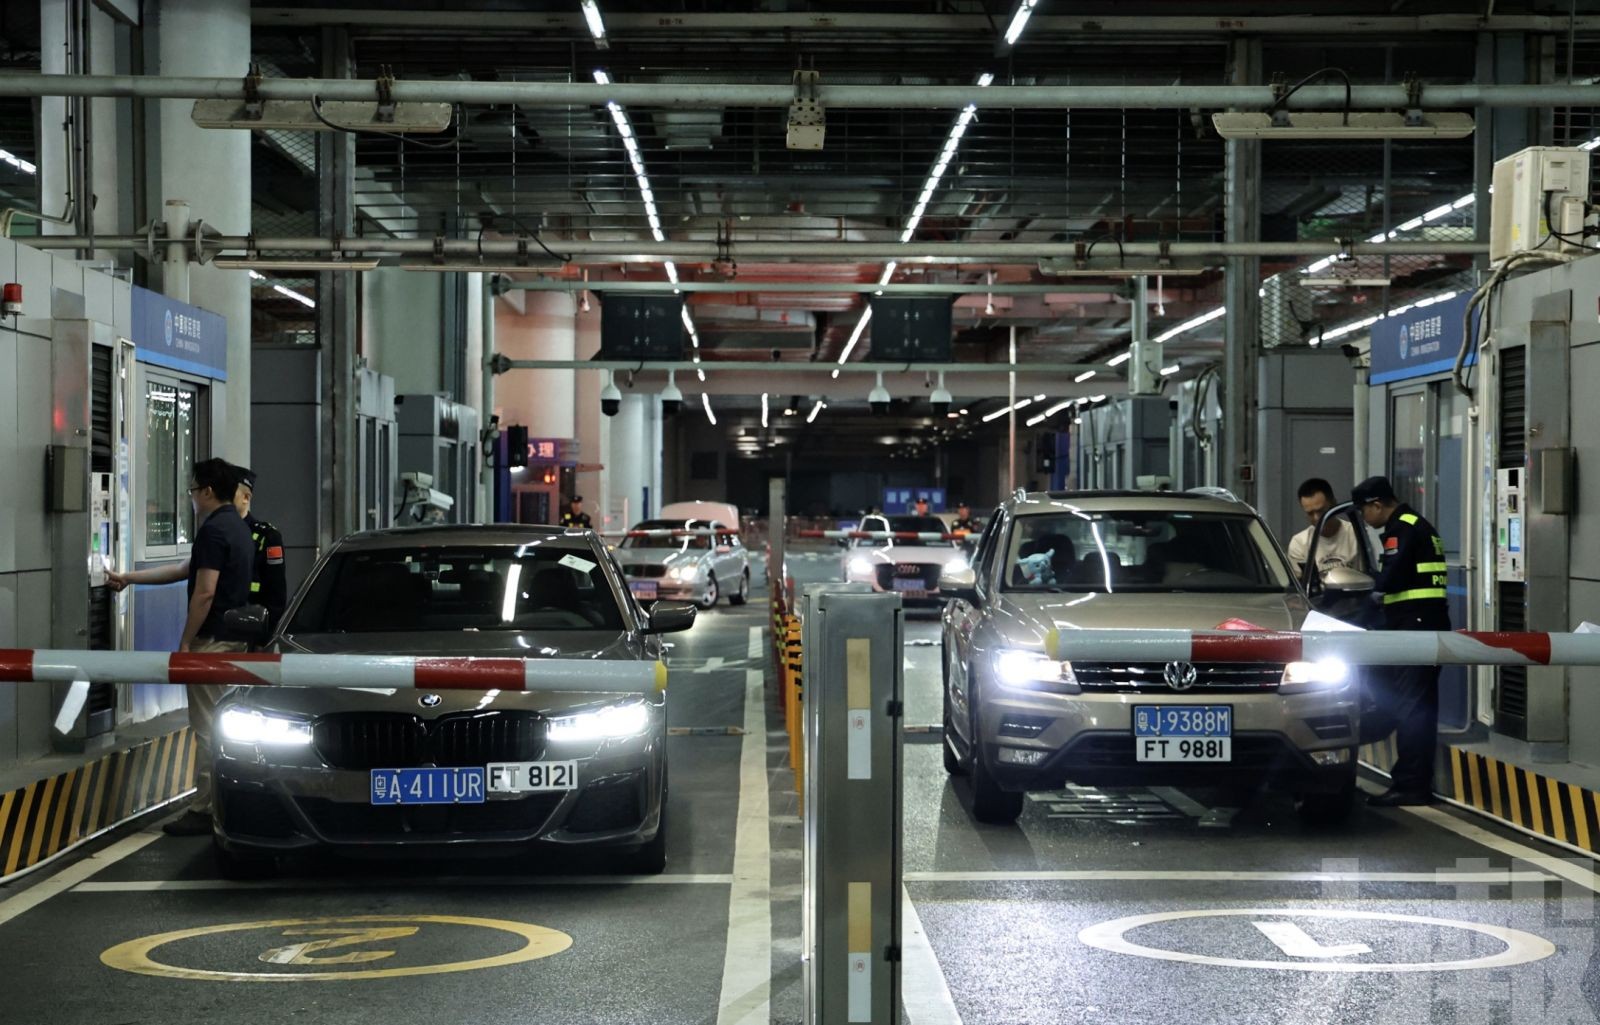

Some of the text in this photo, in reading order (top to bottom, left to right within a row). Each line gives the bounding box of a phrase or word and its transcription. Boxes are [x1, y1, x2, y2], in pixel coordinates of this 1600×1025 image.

[1144, 740, 1223, 758] FT 9881
[528, 765, 573, 787] 8121
[258, 926, 420, 965] 2
[1251, 921, 1373, 958] 1
